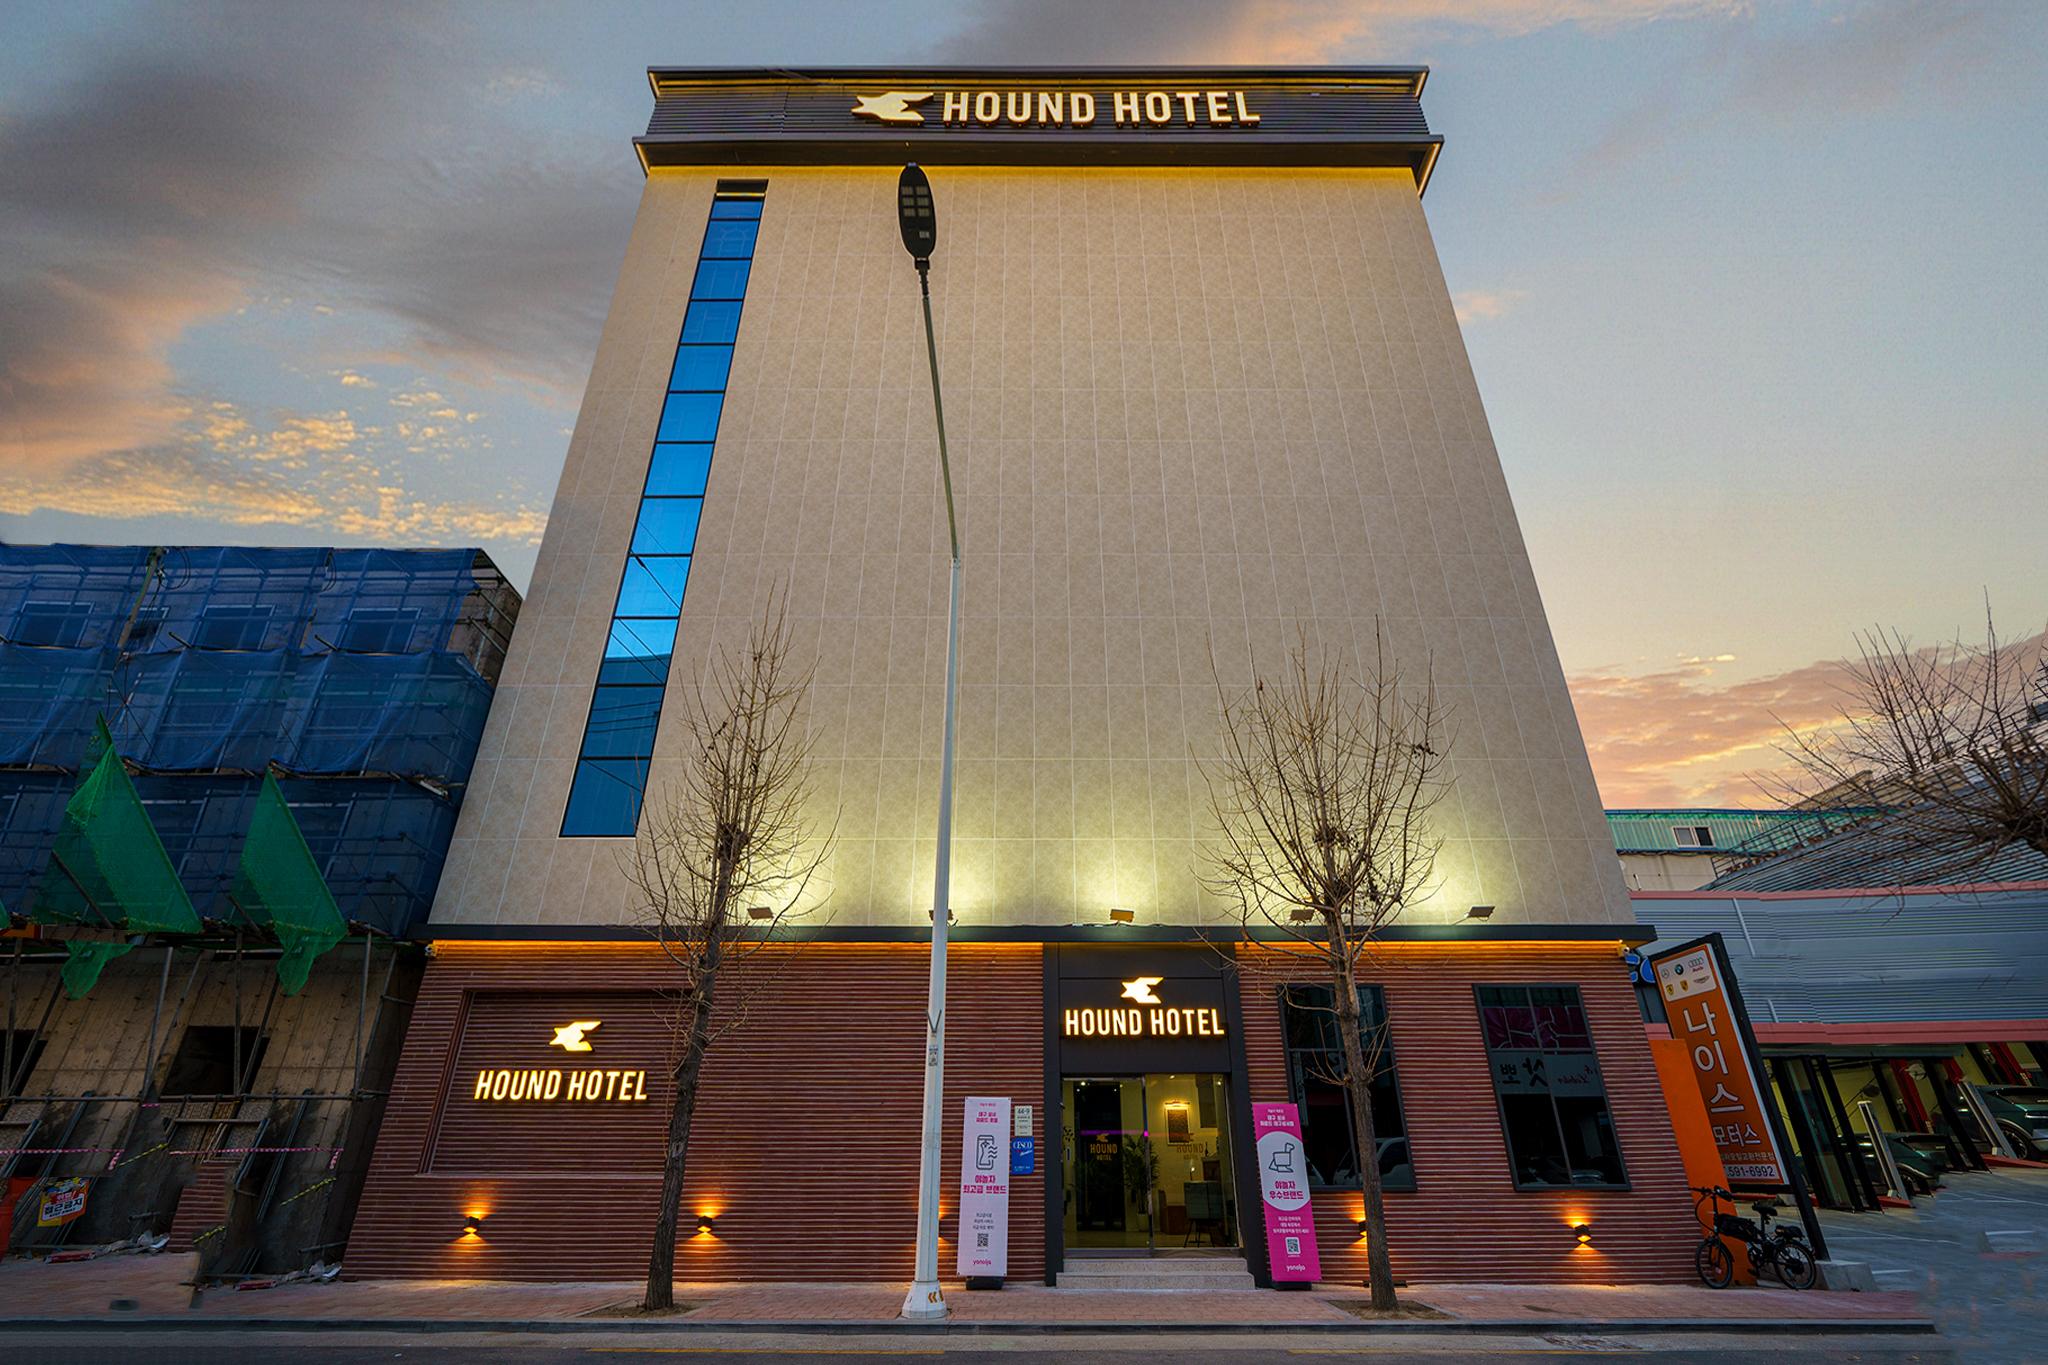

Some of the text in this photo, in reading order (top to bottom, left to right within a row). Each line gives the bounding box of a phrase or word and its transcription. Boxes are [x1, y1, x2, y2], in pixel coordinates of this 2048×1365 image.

[942, 91, 1260, 126] HOUND HOTEL
[1065, 1008, 1225, 1036] HOUND HOTEL
[1683, 1001, 1745, 1113] 나이스
[474, 1069, 648, 1101] HOUND HOTEL
[1090, 1143, 1118, 1154] HOUND
[1712, 1123, 1761, 1148] 모터스
[985, 1184, 1007, 1194] 브랜드
